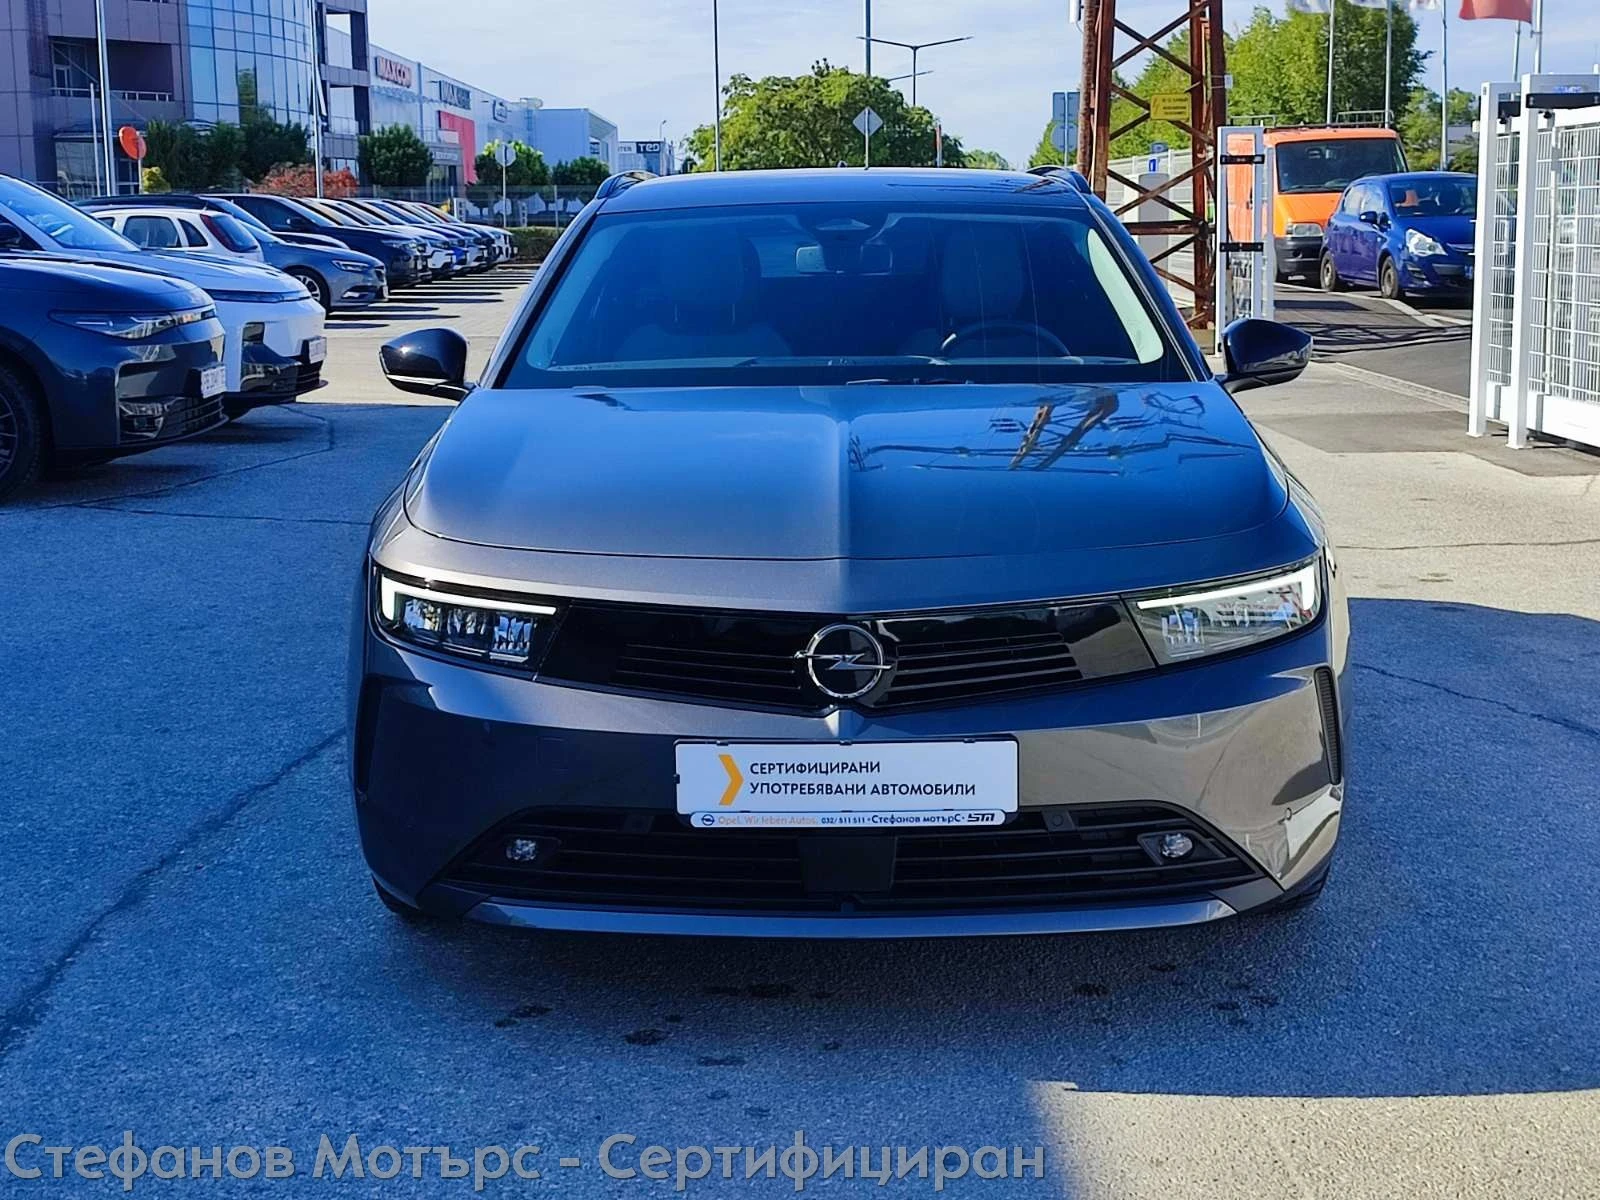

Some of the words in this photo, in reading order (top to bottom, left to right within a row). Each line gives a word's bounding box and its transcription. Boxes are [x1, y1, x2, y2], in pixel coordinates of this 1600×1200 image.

[750, 761, 880, 776] СЕРТИФИЦИРАНИ
[750, 782, 866, 796] УПОТРЕБЯВАНИ
[870, 783, 976, 796] АВТОМОБИЛИ
[871, 814, 921, 825] Стефанов
